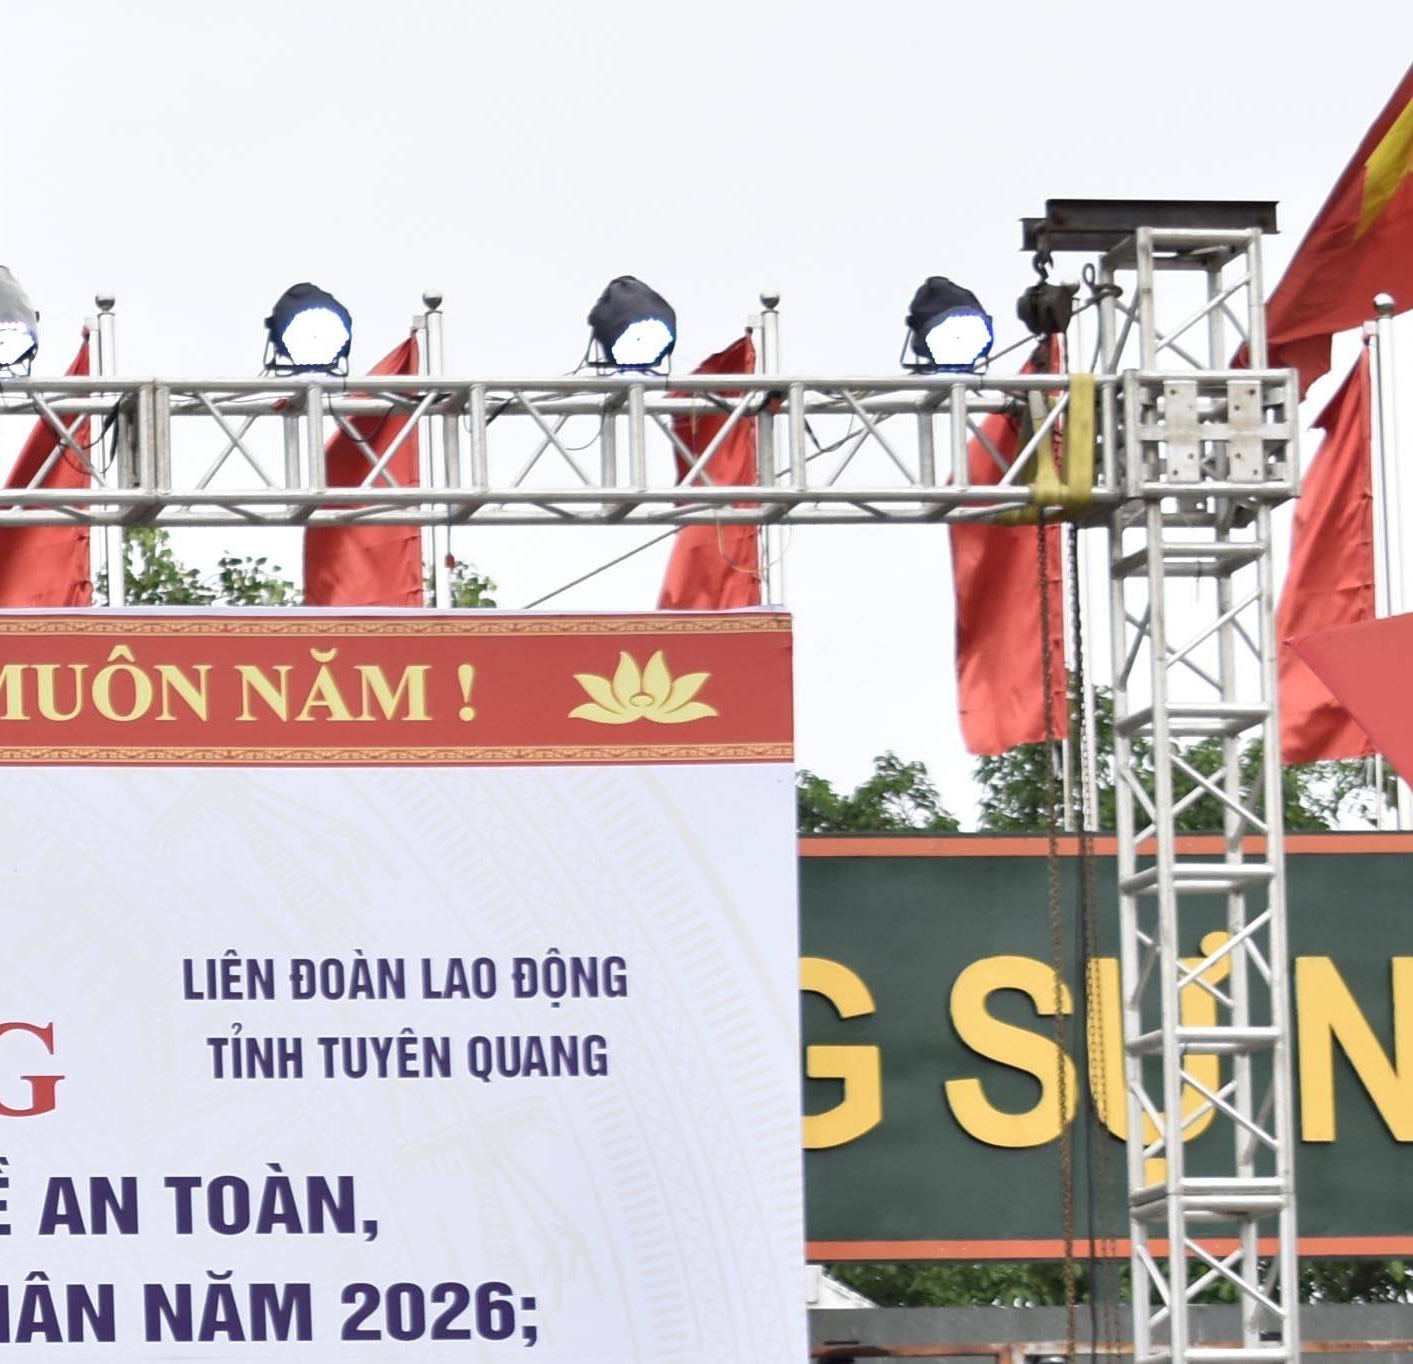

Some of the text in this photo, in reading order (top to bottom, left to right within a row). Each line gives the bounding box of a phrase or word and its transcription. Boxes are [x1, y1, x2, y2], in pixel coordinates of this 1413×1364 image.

[235, 648, 432, 722] NĂM
[458, 664, 475, 722] !
[184, 947, 628, 1008] LIÊN ĐOÀN LAO ĐỘNG
[207, 1022, 608, 1083] TỈNH TUYÊN QUANG
[38, 1176, 139, 1236] AN
[164, 1163, 379, 1242] TOÀN,
[143, 1269, 313, 1342] NĂM
[341, 1281, 539, 1348] 2026;
